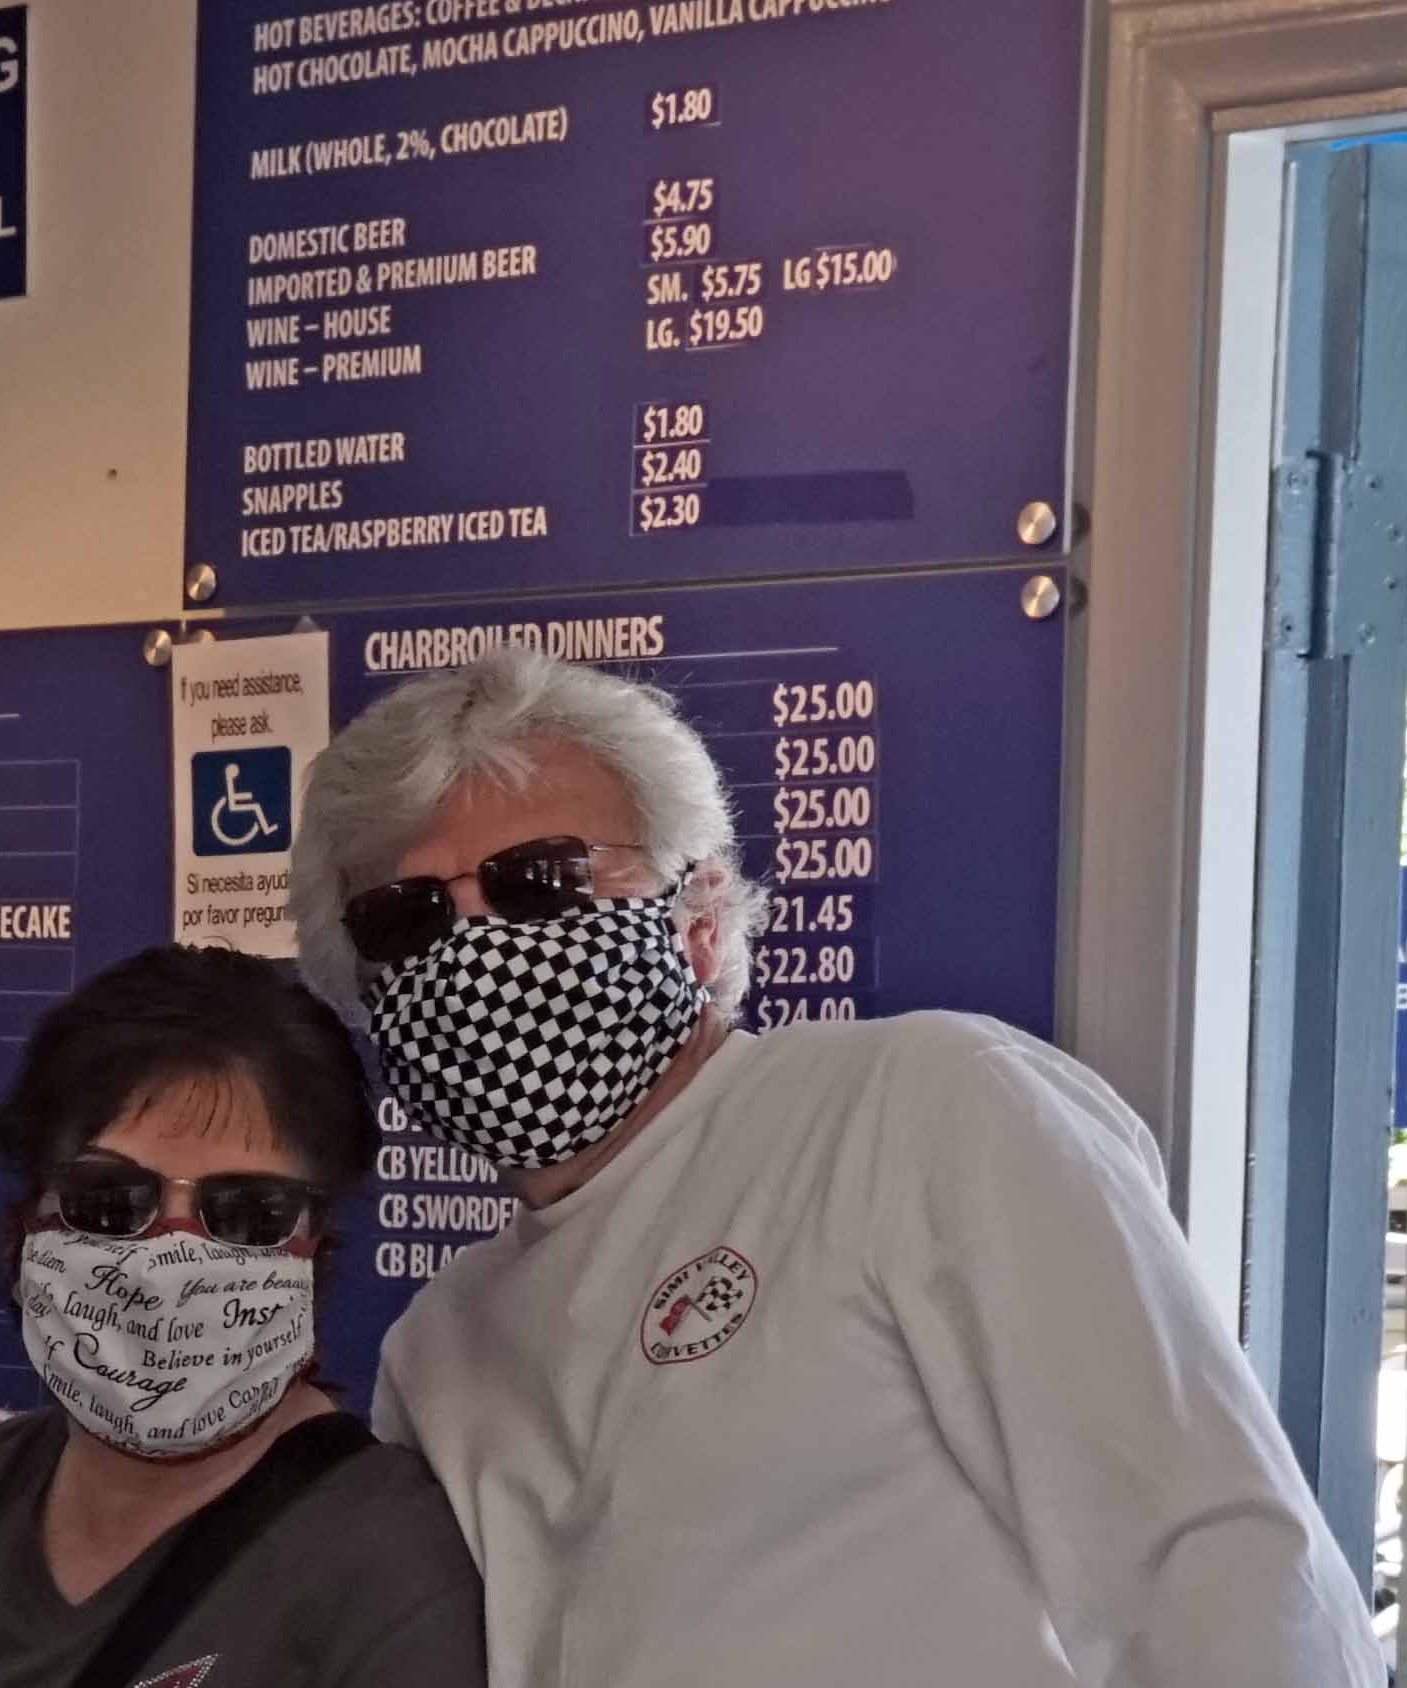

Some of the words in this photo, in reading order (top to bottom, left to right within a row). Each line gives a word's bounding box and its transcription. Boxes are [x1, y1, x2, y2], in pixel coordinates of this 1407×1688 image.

[252, 61, 295, 95] HOT
[297, 43, 418, 89] CHOCOLATE,
[422, 31, 499, 71] MOCHA
[502, 8, 646, 57] CAPPUCCINO,
[651, 87, 712, 130] $1.80
[250, 144, 302, 180] MILK
[305, 132, 393, 175] (WHOLE,
[440, 106, 568, 154] CHOCOLATE)
[653, 178, 714, 218] $4.75
[248, 223, 351, 265] DOMESTIC
[353, 217, 406, 252] BEER
[650, 223, 711, 263] $5.90
[248, 266, 353, 307] IMPORTED
[354, 264, 373, 295] &
[376, 251, 478, 292] PREMIUM
[482, 244, 537, 280] BEER
[646, 271, 689, 305] SM.
[701, 263, 762, 302] $5.75
[783, 256, 812, 291] LG
[816, 248, 895, 290] $15.00
[246, 314, 300, 349] WINE
[323, 304, 392, 340] HOUSE
[243, 438, 332, 475] BOTTLED
[335, 431, 406, 466] WATER
[641, 448, 702, 487] $2.40
[242, 479, 343, 517] SNAPPLES
[241, 527, 286, 558] ICED
[289, 513, 455, 554] TEA/RASPBERRY
[457, 509, 505, 542] ICED
[508, 505, 548, 538] TEA
[548, 615, 664, 661] DINNERS
[189, 679, 209, 707] you
[212, 673, 239, 698] need
[773, 680, 874, 728] $25.00
[211, 715, 247, 743] please
[187, 872, 200, 894] Si
[202, 871, 253, 894] necesita
[183, 906, 203, 930] por
[207, 903, 239, 925] favor
[755, 944, 855, 989] $22.80
[376, 1145, 407, 1181] CB
[410, 1146, 498, 1183] YELLOW
[85, 1265, 164, 1311] Hope
[127, 1319, 159, 1343] and
[168, 1318, 204, 1343] love
[142, 1350, 215, 1372] Believe
[223, 1351, 243, 1367] in
[244, 1314, 302, 1372] yourself
[73, 1333, 187, 1412] Courage
